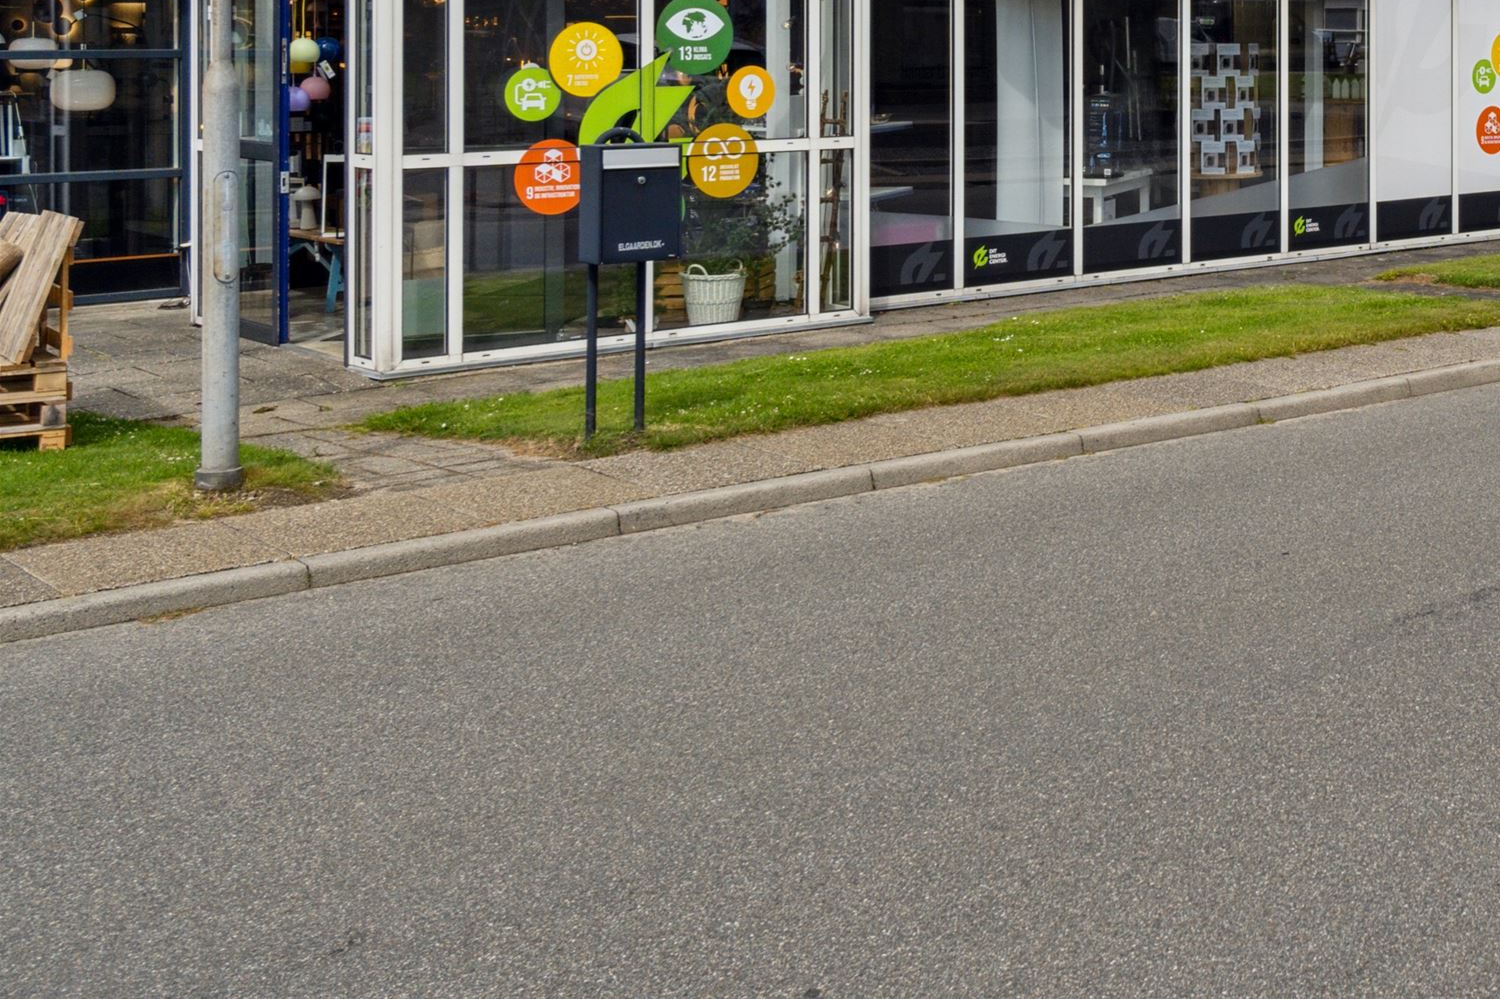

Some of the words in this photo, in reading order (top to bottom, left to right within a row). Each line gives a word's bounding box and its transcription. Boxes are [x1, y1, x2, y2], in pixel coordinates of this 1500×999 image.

[678, 45, 692, 61] 13
[566, 74, 573, 87] 7
[701, 165, 717, 182] 12
[526, 186, 534, 200] 9
